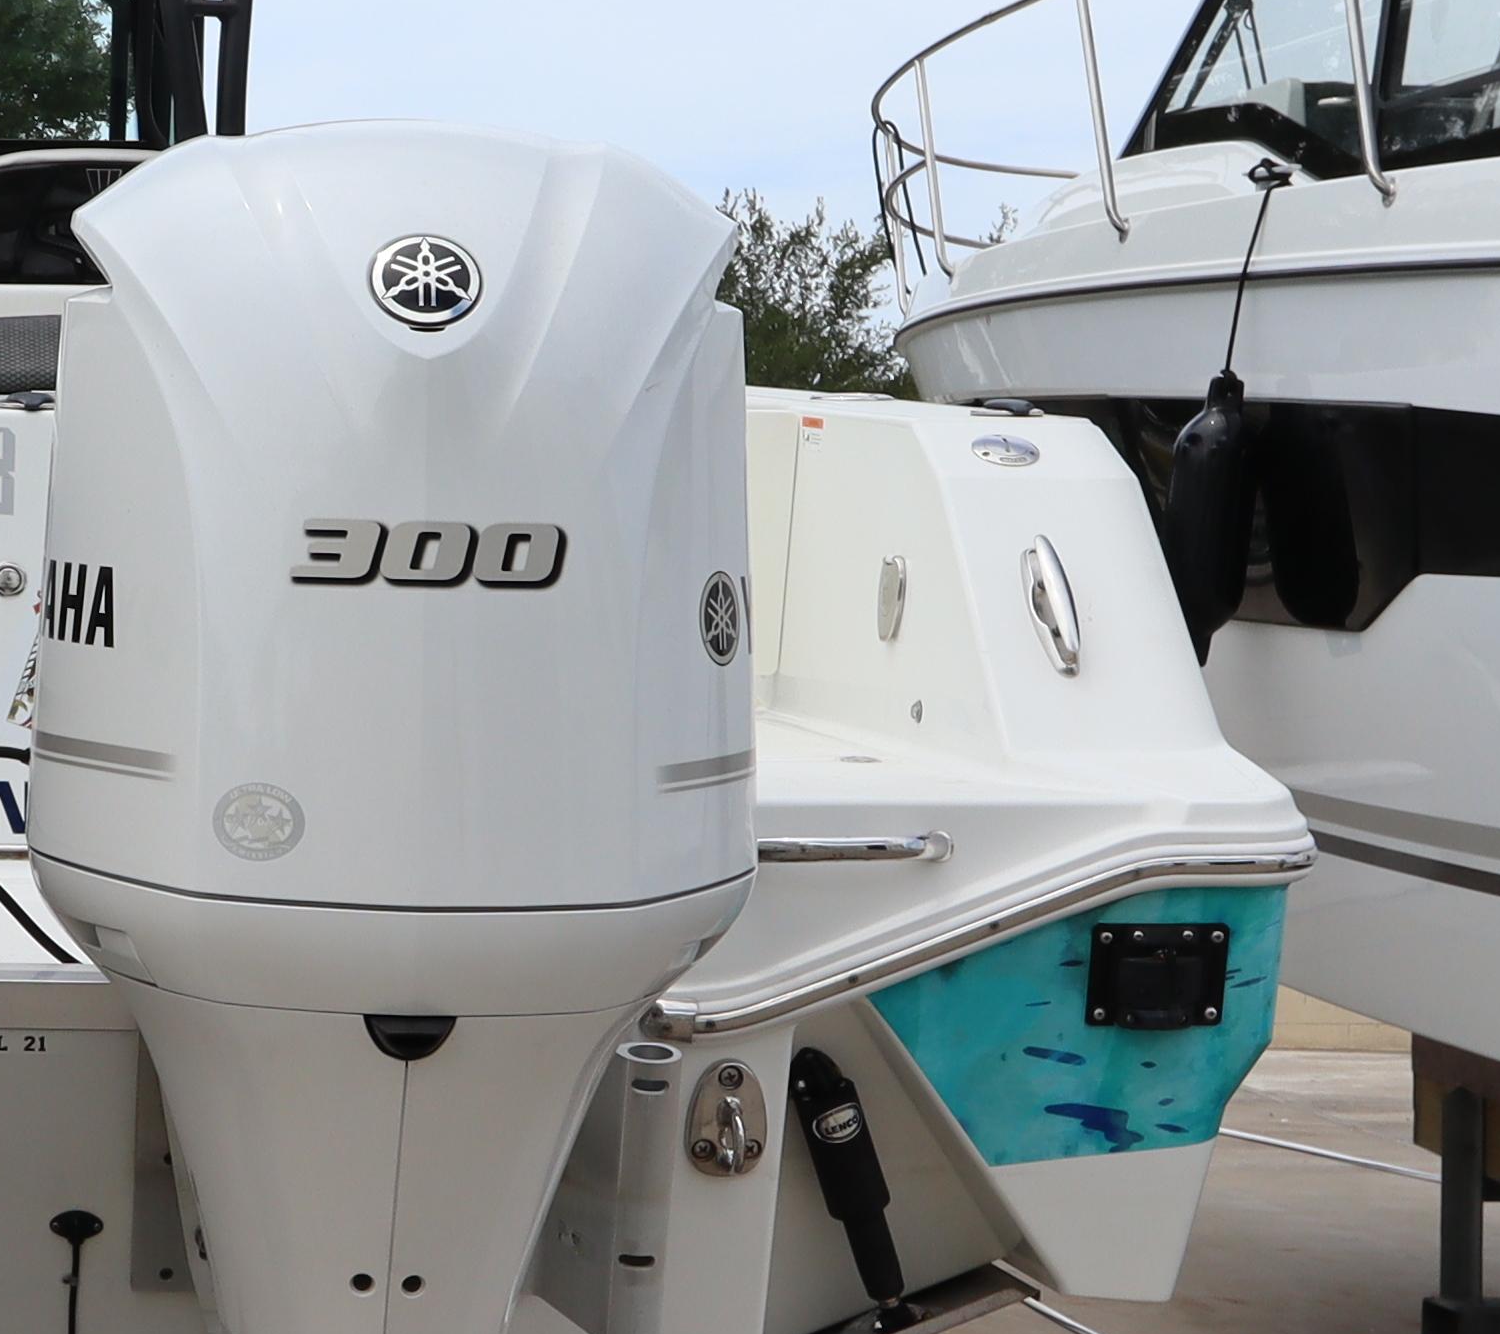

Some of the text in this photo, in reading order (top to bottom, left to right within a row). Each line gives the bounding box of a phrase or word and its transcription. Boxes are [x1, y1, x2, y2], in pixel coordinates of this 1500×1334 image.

[289, 518, 568, 589] 300
[23, 1035, 47, 1052] 21
[824, 1114, 860, 1136] LENCO
